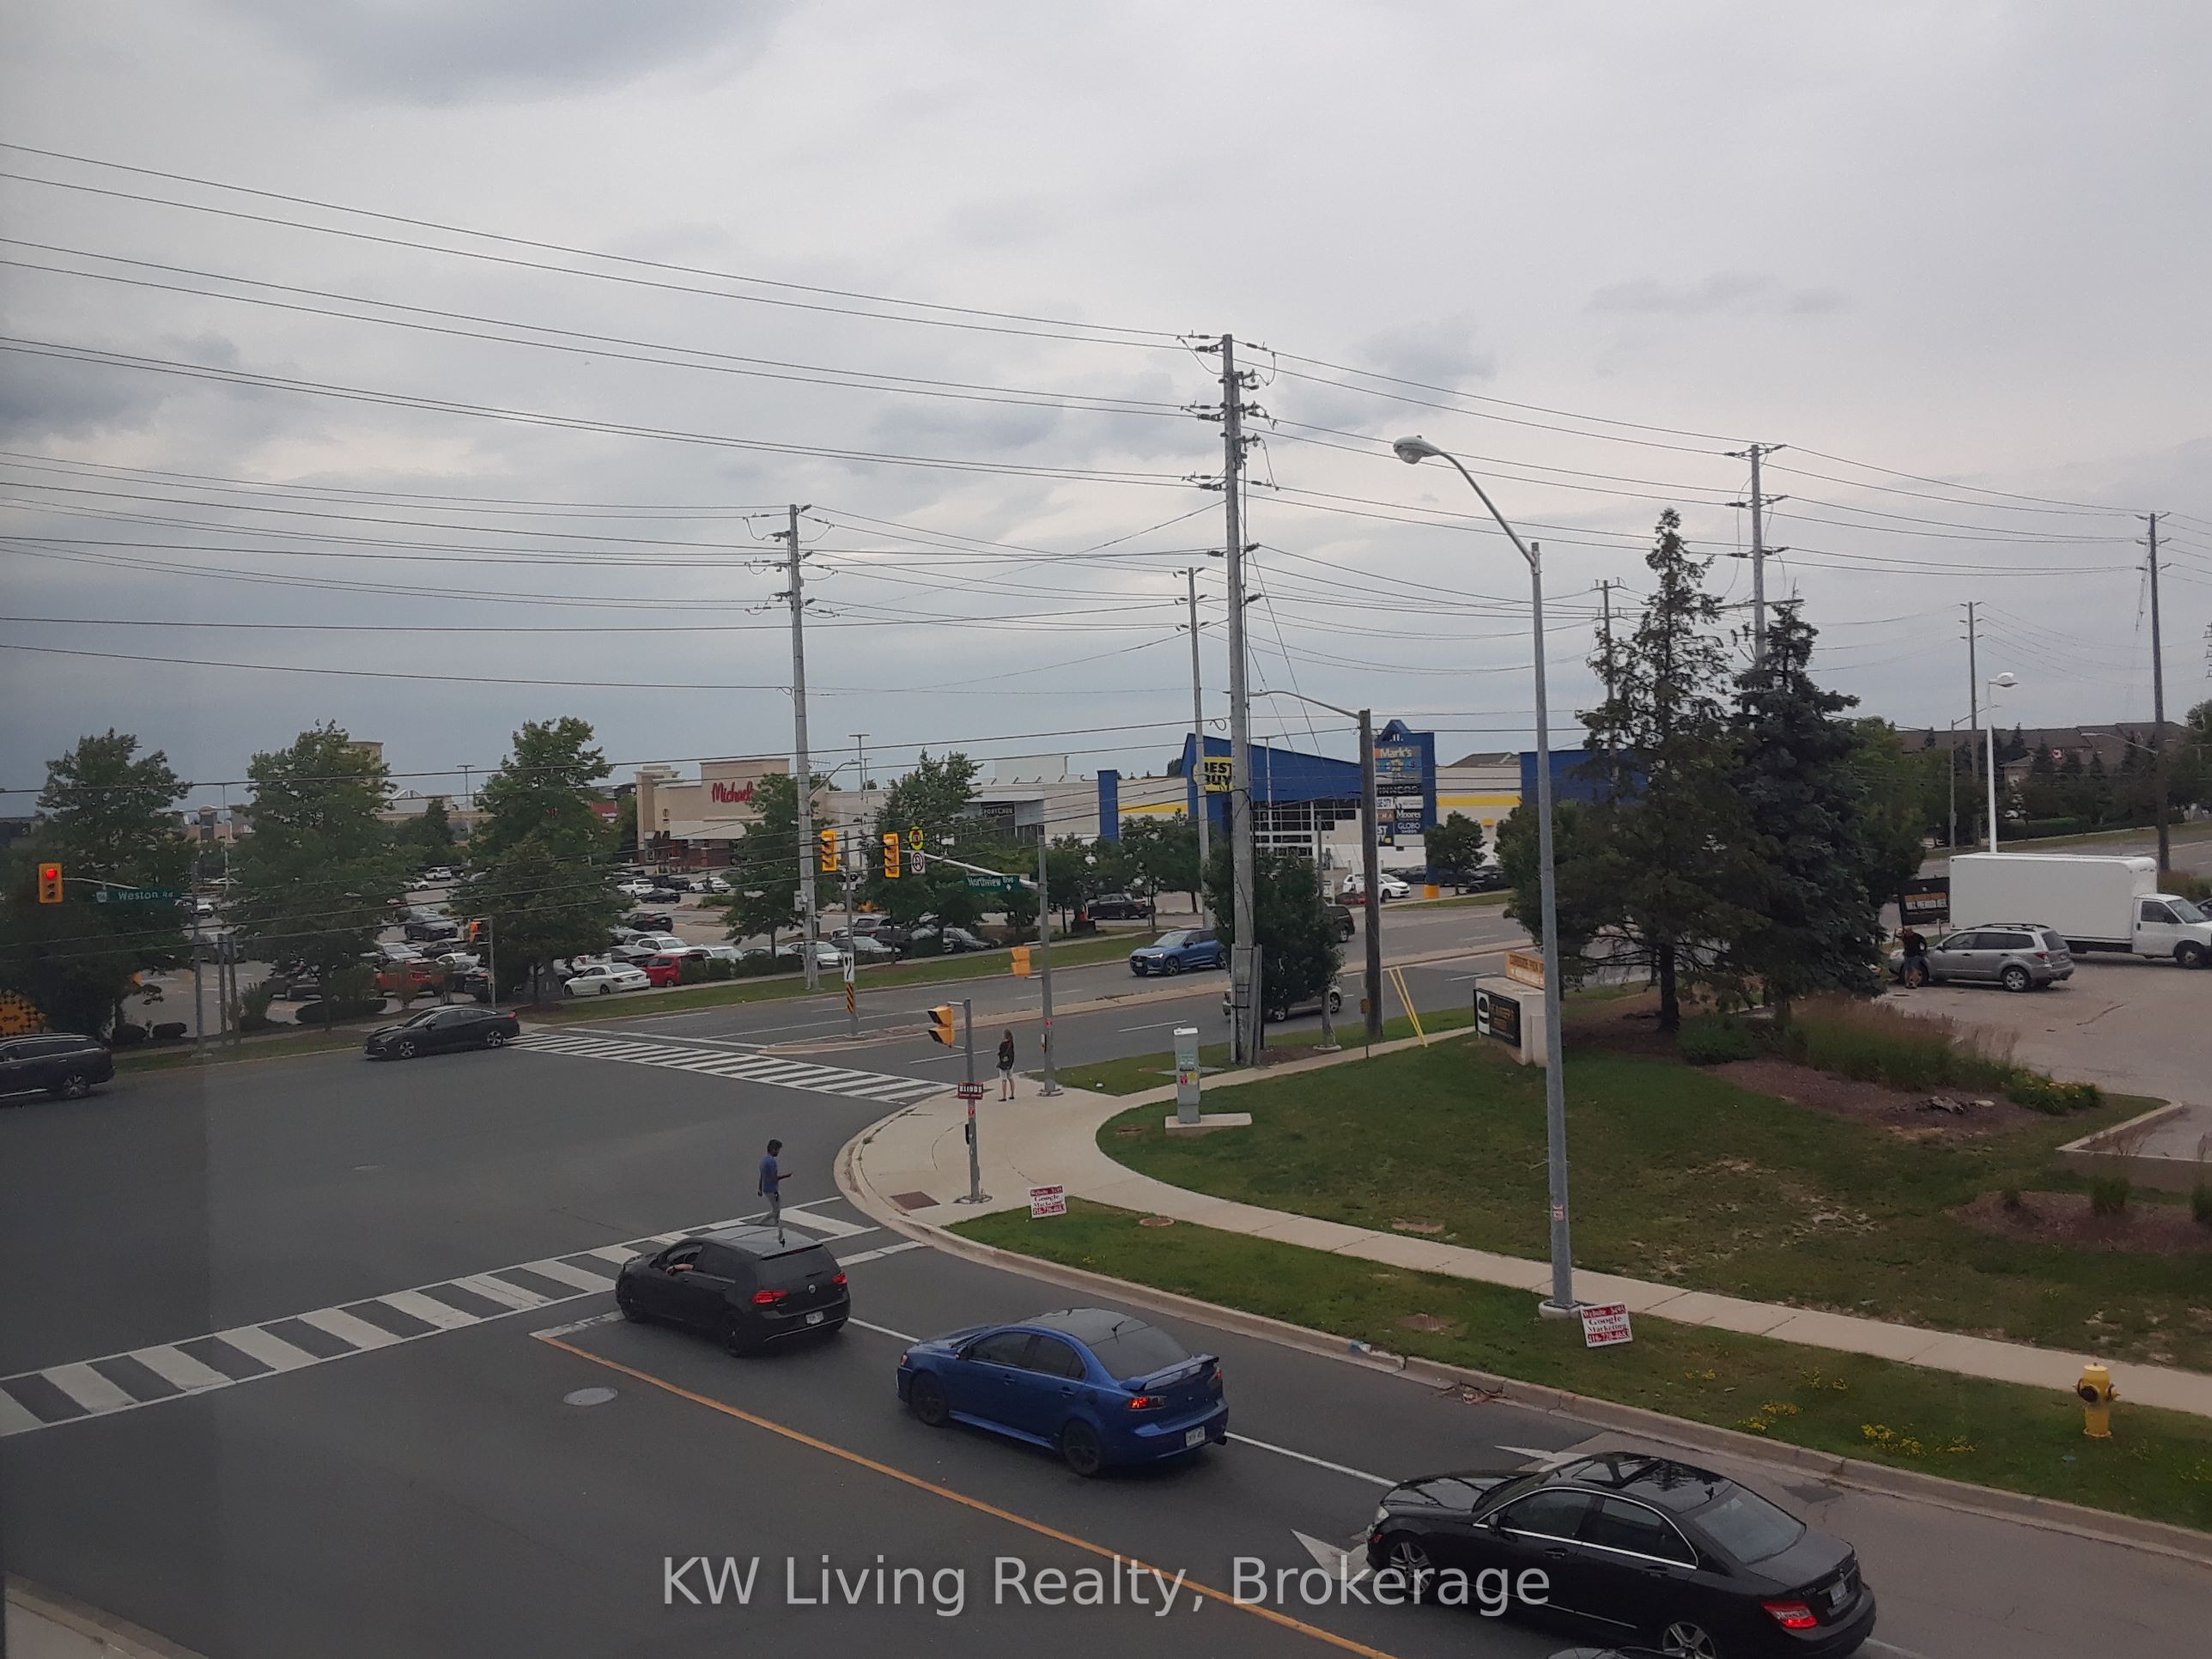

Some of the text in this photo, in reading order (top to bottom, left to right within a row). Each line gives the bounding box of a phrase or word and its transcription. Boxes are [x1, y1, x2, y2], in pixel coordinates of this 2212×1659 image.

[1381, 747, 1413, 757] Mark's
[712, 781, 756, 803] Michael
[1396, 810, 1422, 819] Moores
[118, 891, 158, 901] Weston
[1589, 1315, 1622, 1325] Google
